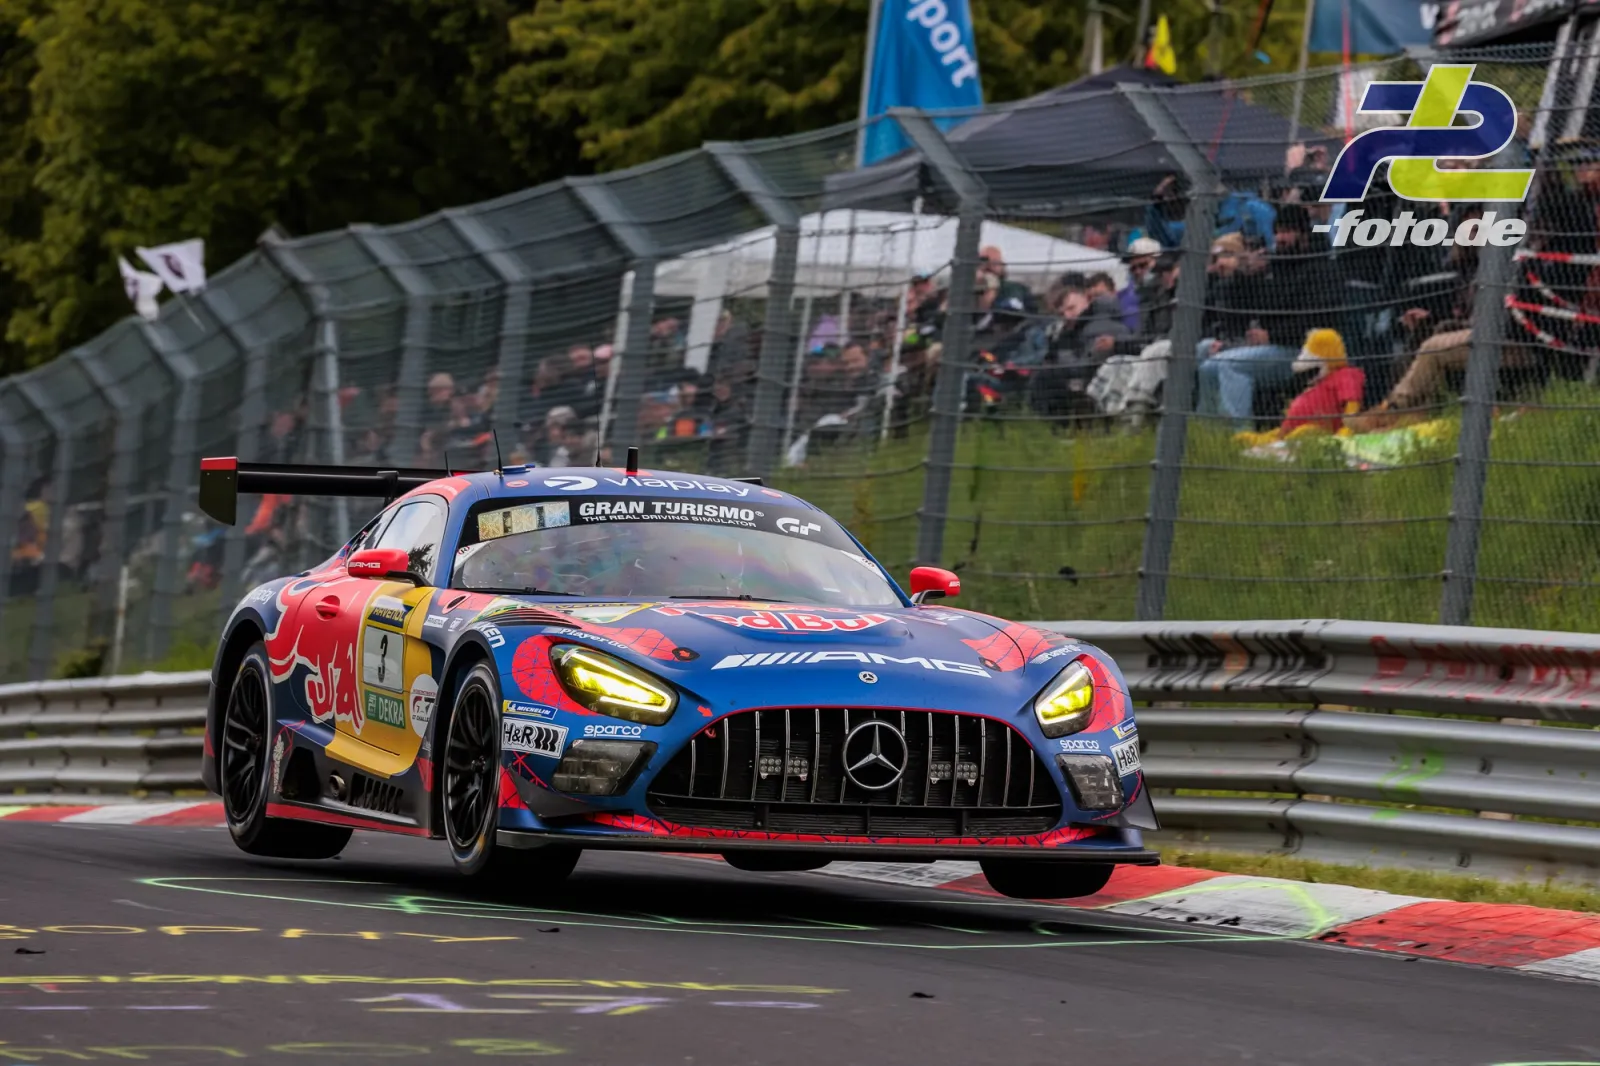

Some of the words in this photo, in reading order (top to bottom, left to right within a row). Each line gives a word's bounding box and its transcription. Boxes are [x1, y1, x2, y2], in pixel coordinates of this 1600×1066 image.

[906, 0, 977, 88] port
[604, 476, 750, 498] viaplay
[579, 501, 645, 516] GRAN
[691, 516, 757, 528] SIMULATOR
[377, 634, 389, 683] 3
[808, 651, 993, 679] AMG
[378, 696, 405, 726] DEKRA
[516, 705, 552, 715] MICHELIN
[503, 722, 535, 746] H&R
[583, 724, 642, 737] sparco
[1060, 739, 1100, 752] sparco
[1115, 746, 1138, 769] H&R
